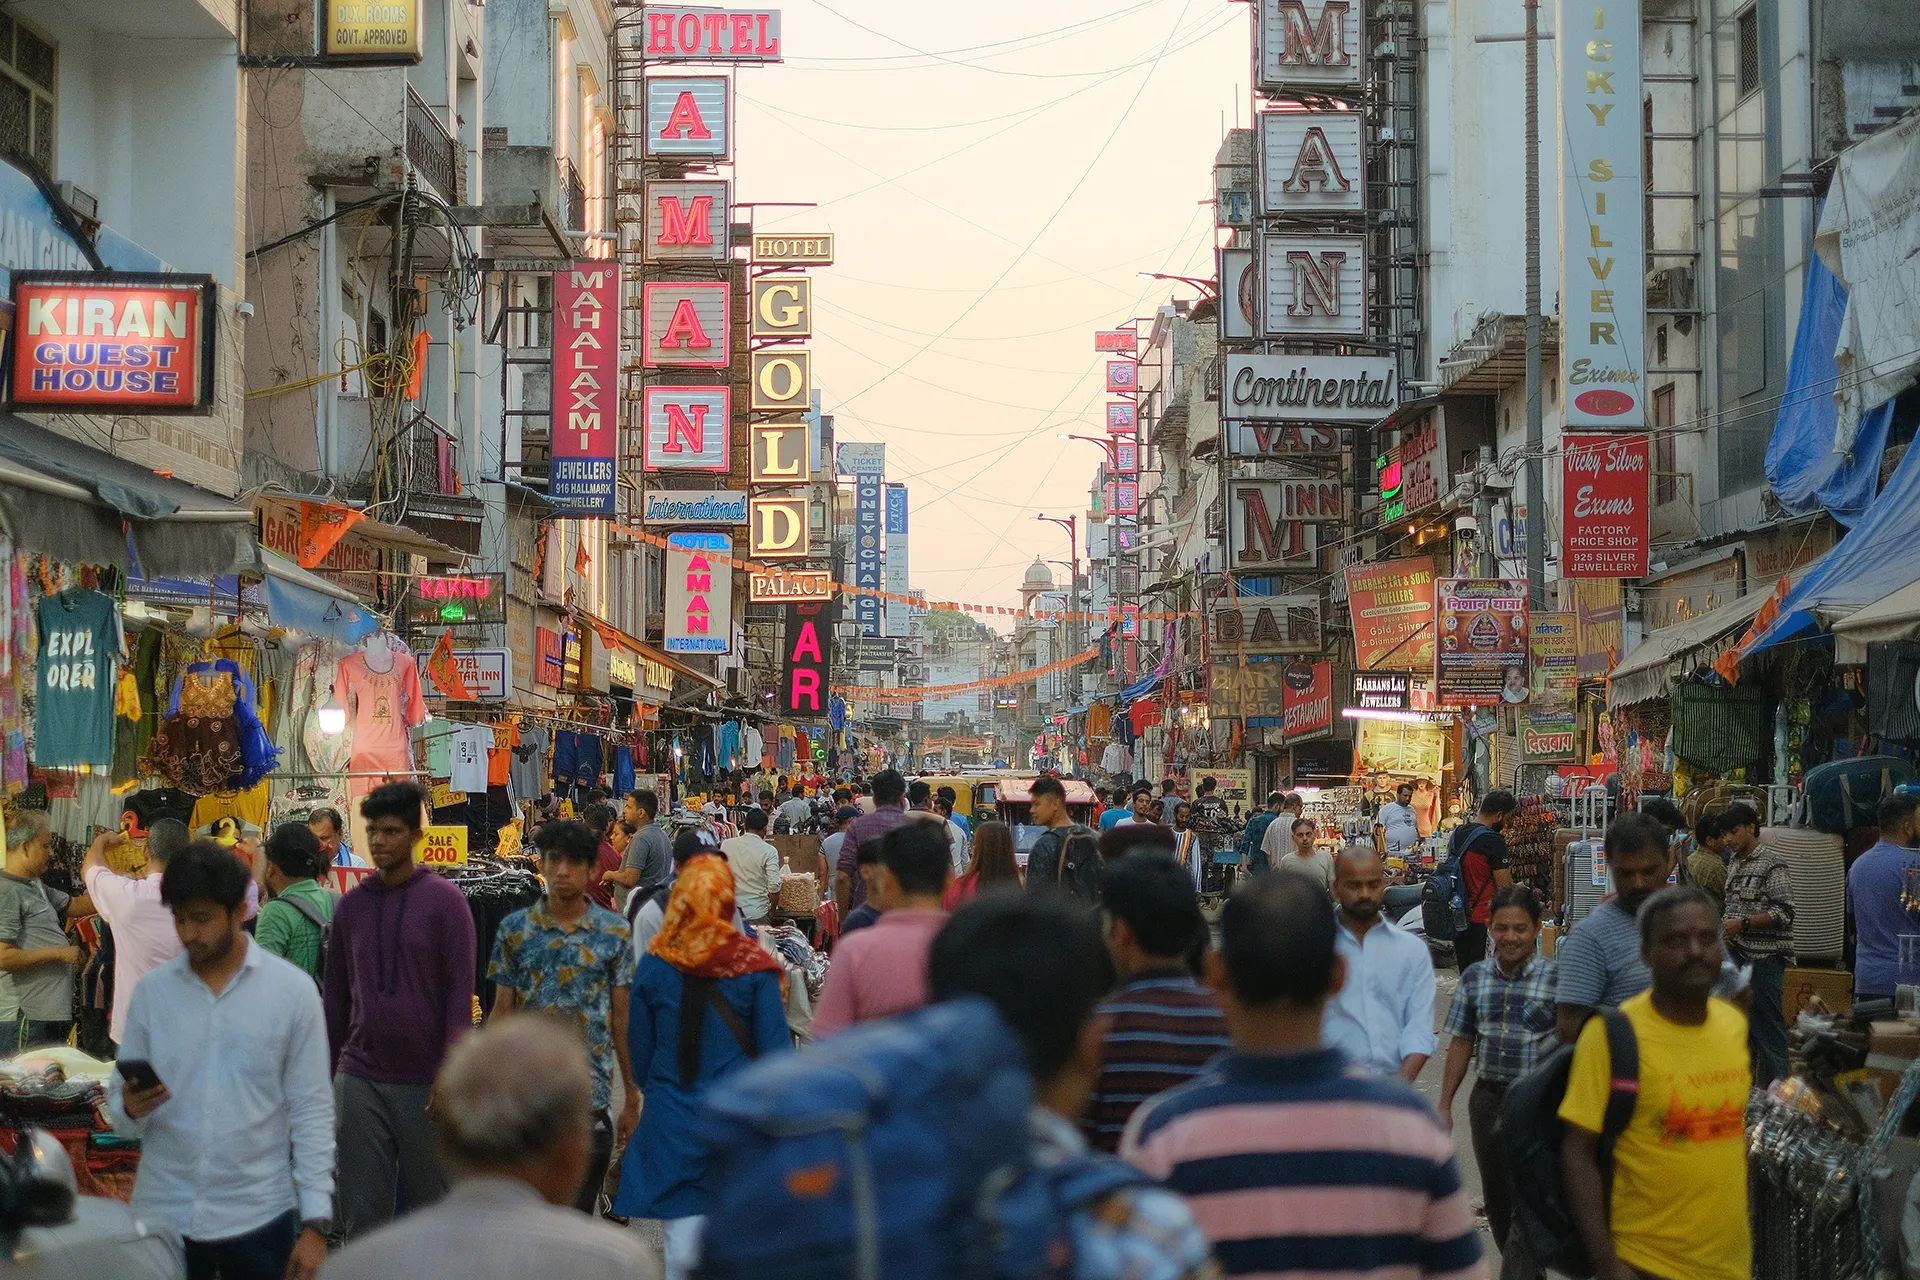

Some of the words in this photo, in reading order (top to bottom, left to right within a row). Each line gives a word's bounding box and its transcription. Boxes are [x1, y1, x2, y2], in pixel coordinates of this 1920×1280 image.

[337, 5, 362, 23] DLX.
[366, 6, 407, 24] ROOMS
[336, 28, 362, 44] GOVT.
[364, 29, 408, 45] APPROVED
[647, 14, 778, 55] HOTEL
[758, 239, 828, 257] HOTEL
[1587, 160, 1617, 345] SILVER
[657, 91, 713, 454] AMAN
[28, 298, 187, 338] KIRAN
[1096, 334, 1136, 349] HOTEL
[34, 342, 179, 367] GUEST
[569, 271, 604, 451] MAHALAXMI
[32, 369, 179, 395] HOUSE
[1232, 367, 1394, 408] Continental
[757, 285, 804, 551] GOLD
[1565, 442, 1601, 479] Vicky
[1605, 442, 1644, 472] Silver
[556, 461, 612, 480] JEWELLERS
[556, 483, 570, 493] 916
[571, 483, 612, 495] HALLMARK
[645, 494, 747, 521] International
[860, 475, 877, 533] MONEY
[1285, 483, 1340, 516] INN
[1578, 526, 1631, 535] FACTORY
[669, 533, 730, 550] HOTEL
[1570, 538, 1604, 546] PRICE
[1608, 538, 1639, 546] SHOP
[319, 541, 371, 571] ENCIES
[1574, 553, 1593, 561] 925
[1596, 553, 1635, 561] SILVER
[1571, 563, 1638, 571] JEWELLERY
[420, 577, 490, 599] KAKKU
[754, 577, 827, 597] PALACE
[1403, 577, 1410, 587] &
[1410, 571, 1431, 585] SONS
[686, 555, 711, 634] AMAN
[1374, 589, 1415, 605] JEWELLERS
[1447, 598, 1489, 612] निशान
[1491, 598, 1523, 612] यात्रा
[1215, 606, 1316, 643] BAR
[1369, 627, 1396, 636] Gold,
[666, 638, 729, 651] INTERNATIONAL
[1369, 635, 1404, 647] Diamond
[47, 660, 95, 691] ORER
[481, 670, 500, 681] INN
[1356, 677, 1391, 692] HARBANS
[1391, 677, 1406, 692] LAL
[1360, 692, 1402, 709] JEWELLERS
[1284, 696, 1329, 731] RESTAURANT
[1525, 728, 1573, 754] दिलबाग
[439, 794, 462, 804] 150
[428, 835, 453, 847] SALE
[423, 847, 458, 863] 200
